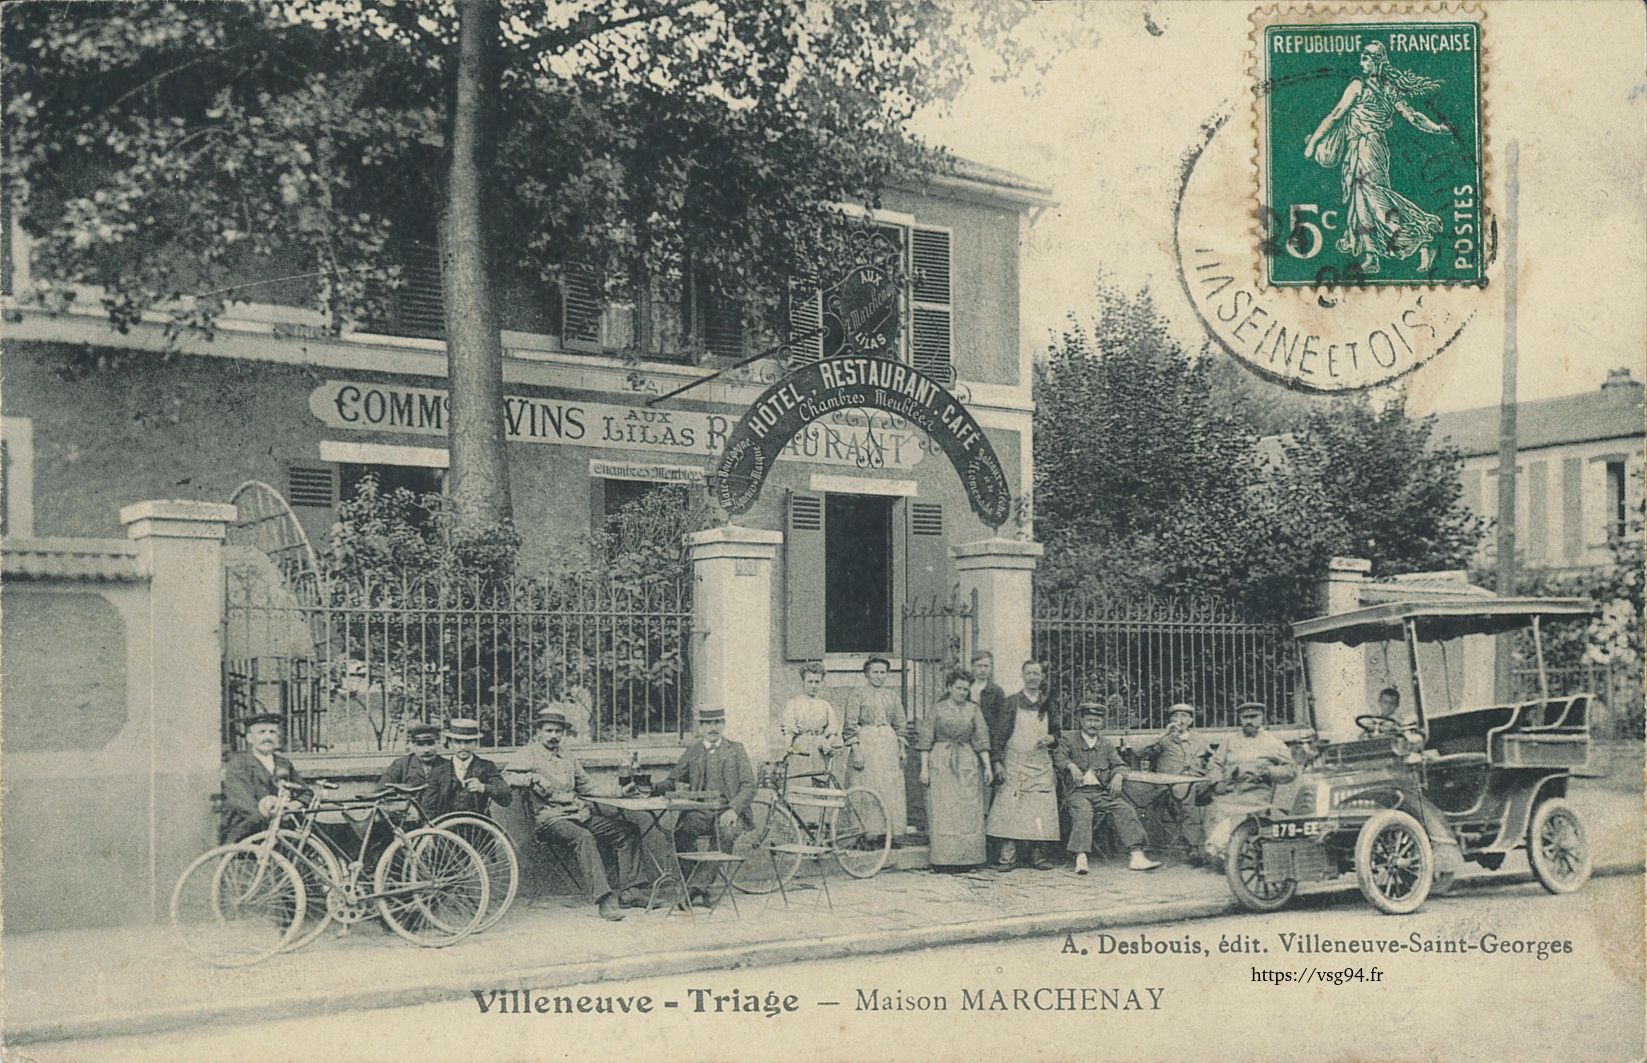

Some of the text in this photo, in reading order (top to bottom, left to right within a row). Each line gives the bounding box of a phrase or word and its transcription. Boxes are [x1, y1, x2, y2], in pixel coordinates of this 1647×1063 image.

[1273, 33, 1471, 56] REPUBLIQUE FRANÇAISE
[1454, 184, 1473, 270] POSTES
[861, 270, 882, 286] AUX
[1328, 342, 1358, 377] ET
[503, 398, 586, 440] VINS
[624, 409, 671, 424] AUX
[747, 383, 805, 438] HÔTEL
[819, 358, 940, 408] RESTAURANT
[941, 404, 980, 451] CAFÉ
[799, 387, 865, 421] Chambres
[602, 415, 695, 447] LILAS
